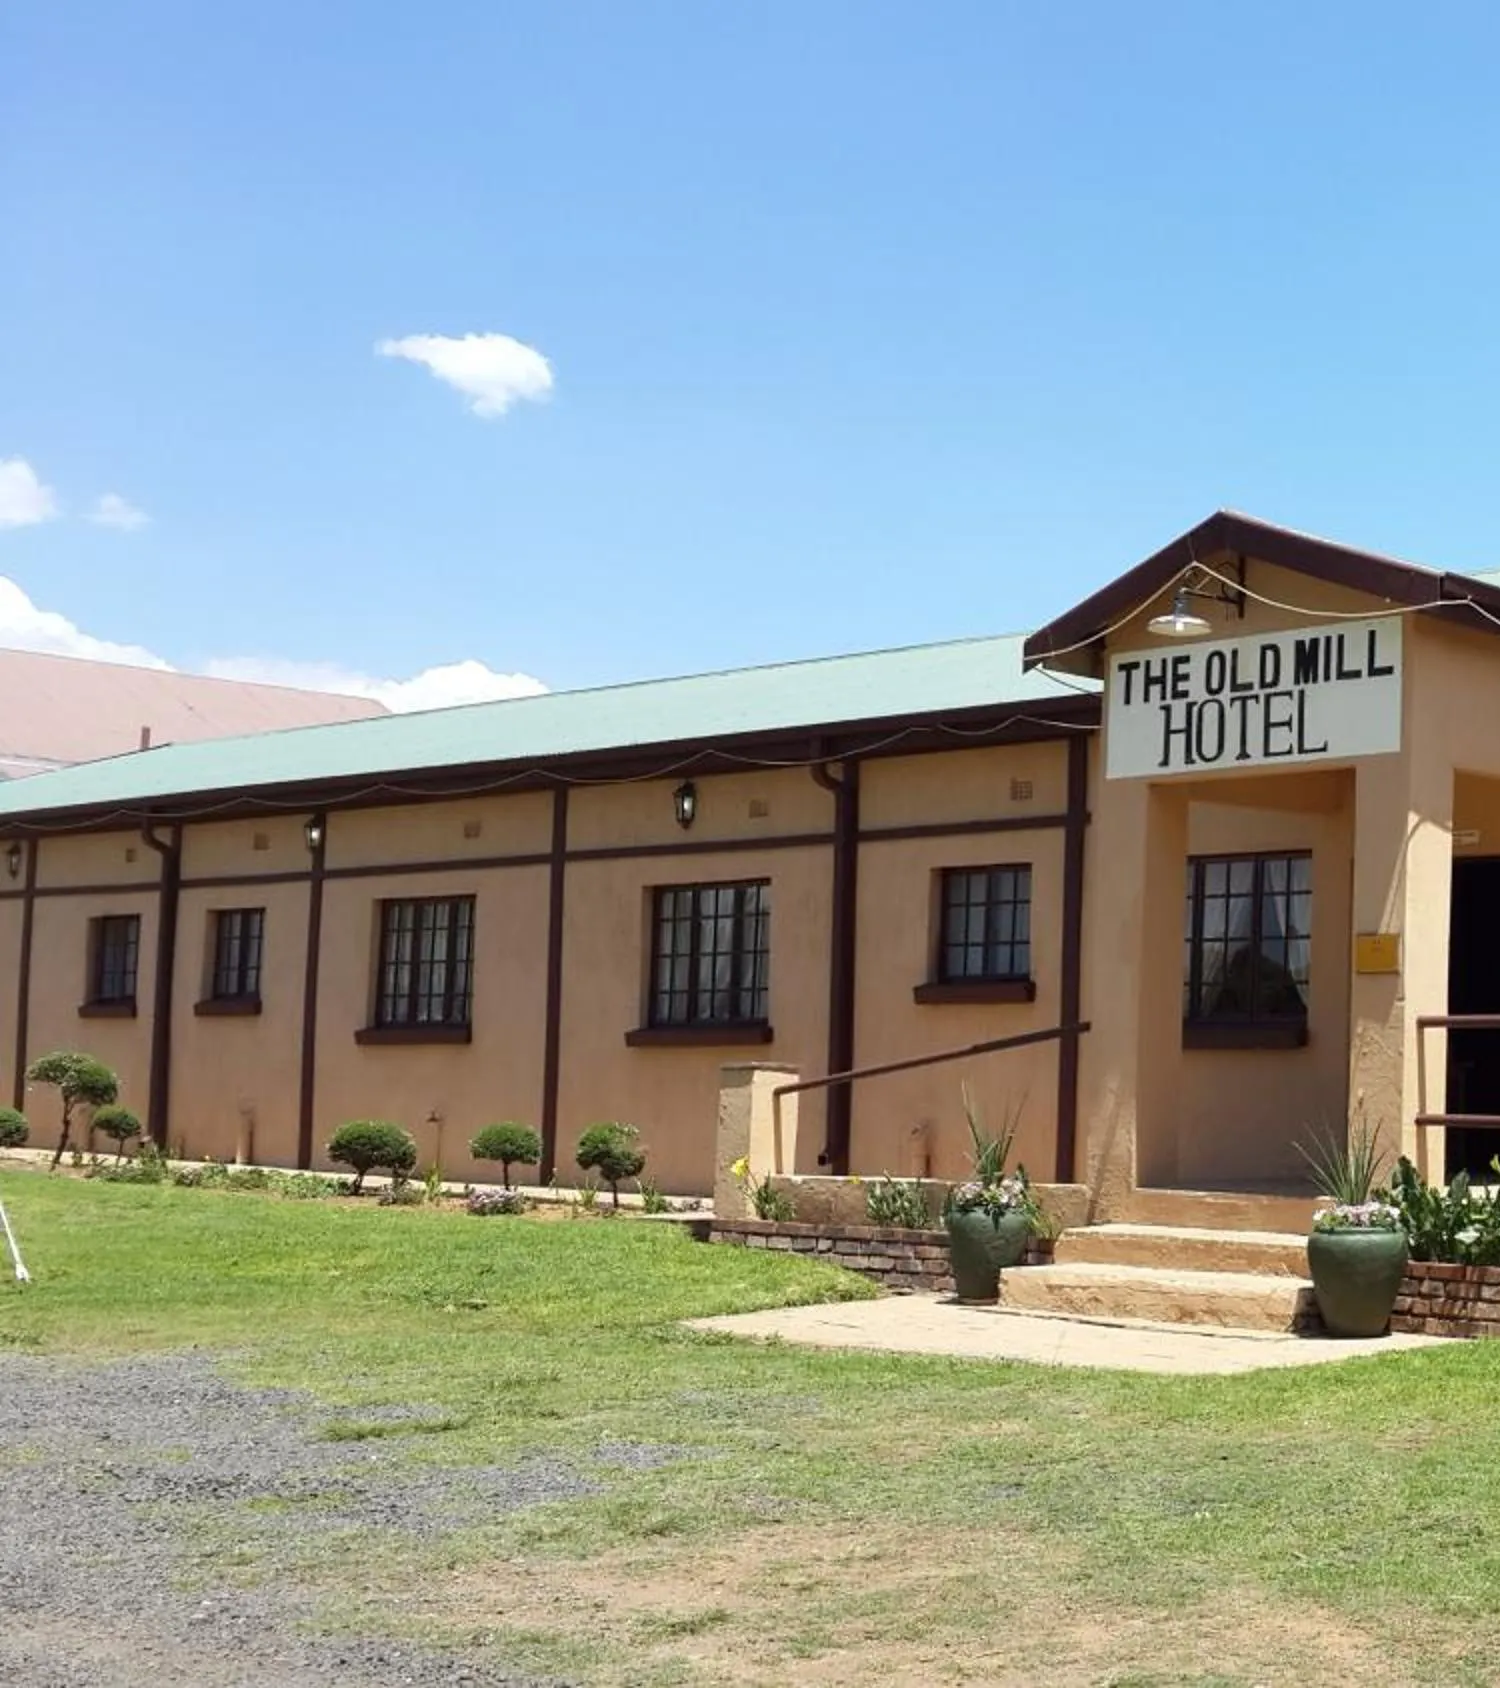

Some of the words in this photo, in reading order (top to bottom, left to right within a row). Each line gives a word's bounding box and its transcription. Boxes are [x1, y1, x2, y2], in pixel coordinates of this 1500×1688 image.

[1117, 655, 1191, 705] THE
[1205, 643, 1281, 696] OLD
[1293, 629, 1394, 686] MILL
[1158, 689, 1328, 767] HOTEL
